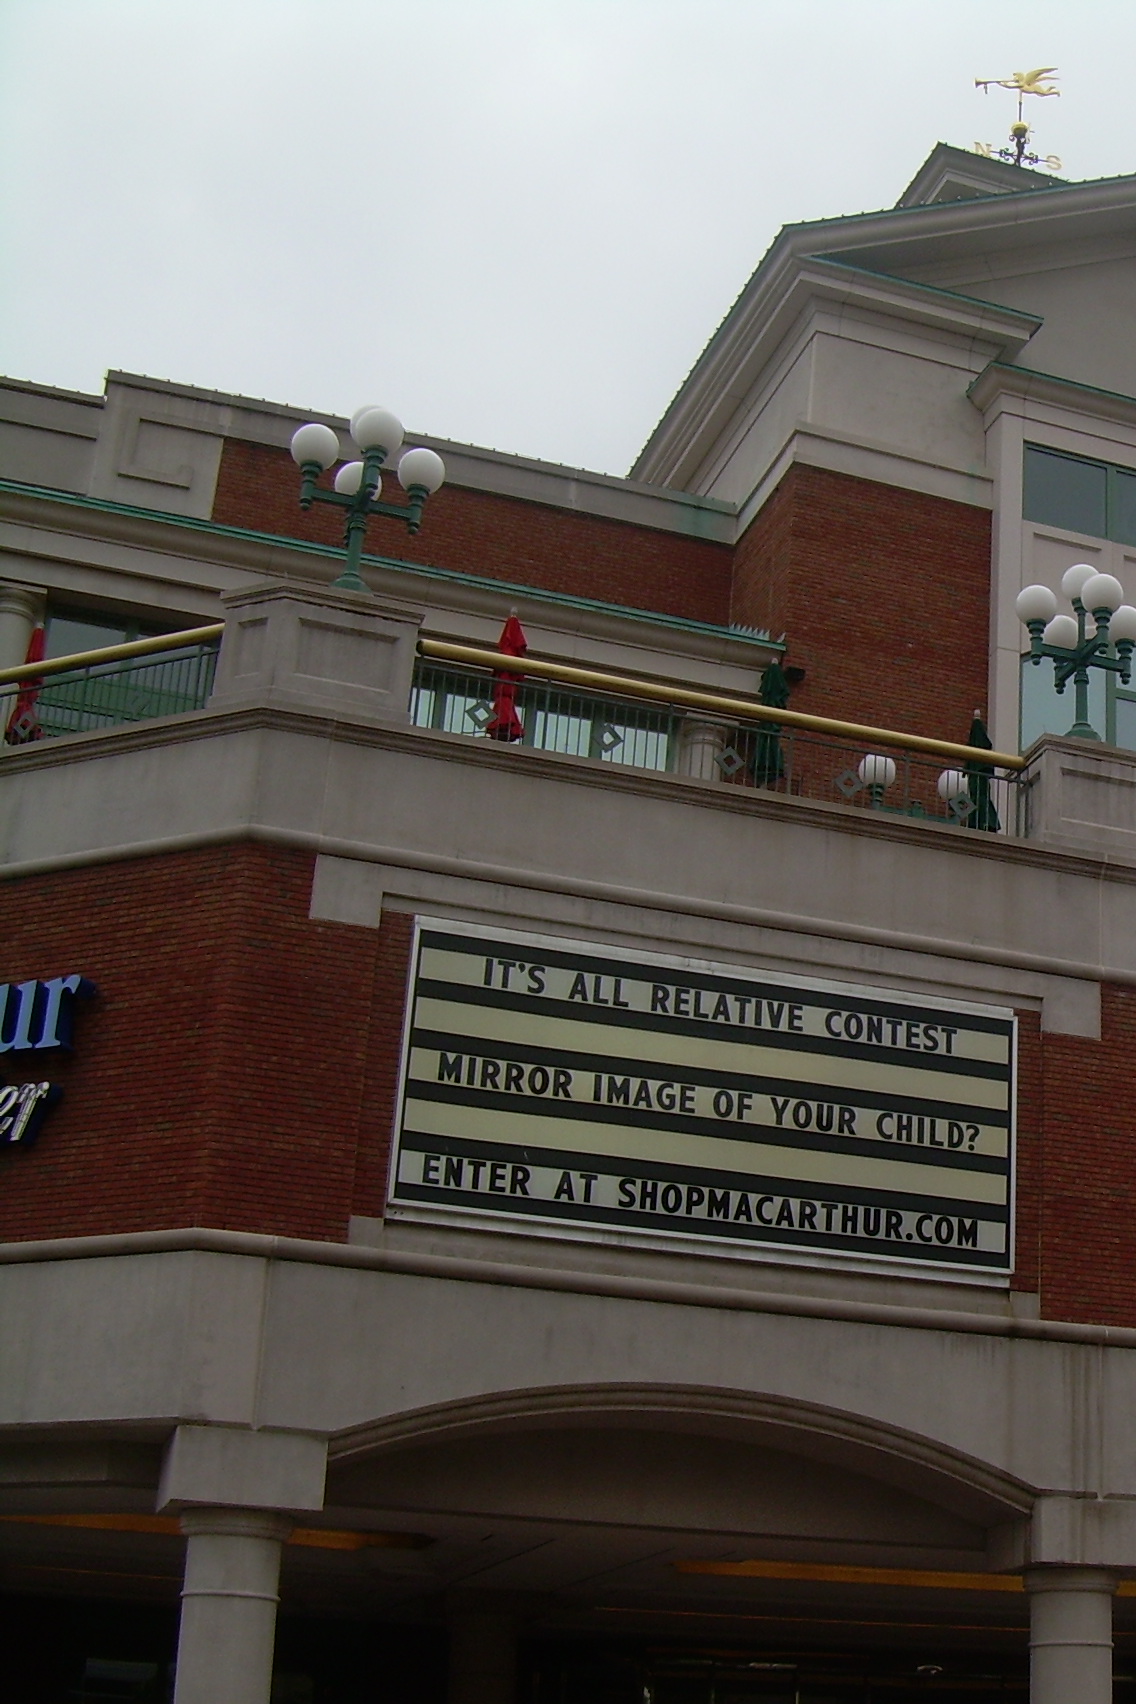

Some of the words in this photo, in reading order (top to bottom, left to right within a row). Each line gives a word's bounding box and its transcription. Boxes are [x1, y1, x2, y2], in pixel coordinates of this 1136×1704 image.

[484, 957, 546, 995] IT'S
[568, 972, 629, 1009] ALL
[651, 985, 804, 1031] RELATIVE
[824, 1010, 957, 1054] CONTEST
[437, 1052, 573, 1099] MIRROR
[592, 1073, 697, 1114] IMAGE
[713, 1089, 753, 1120] OF
[770, 1096, 856, 1135] YOUR
[876, 1112, 981, 1151] CHILD?
[421, 1154, 531, 1196] ENTER
[554, 1171, 598, 1203] AT
[617, 1177, 980, 1249] SHOPMACARTHUR.COM
